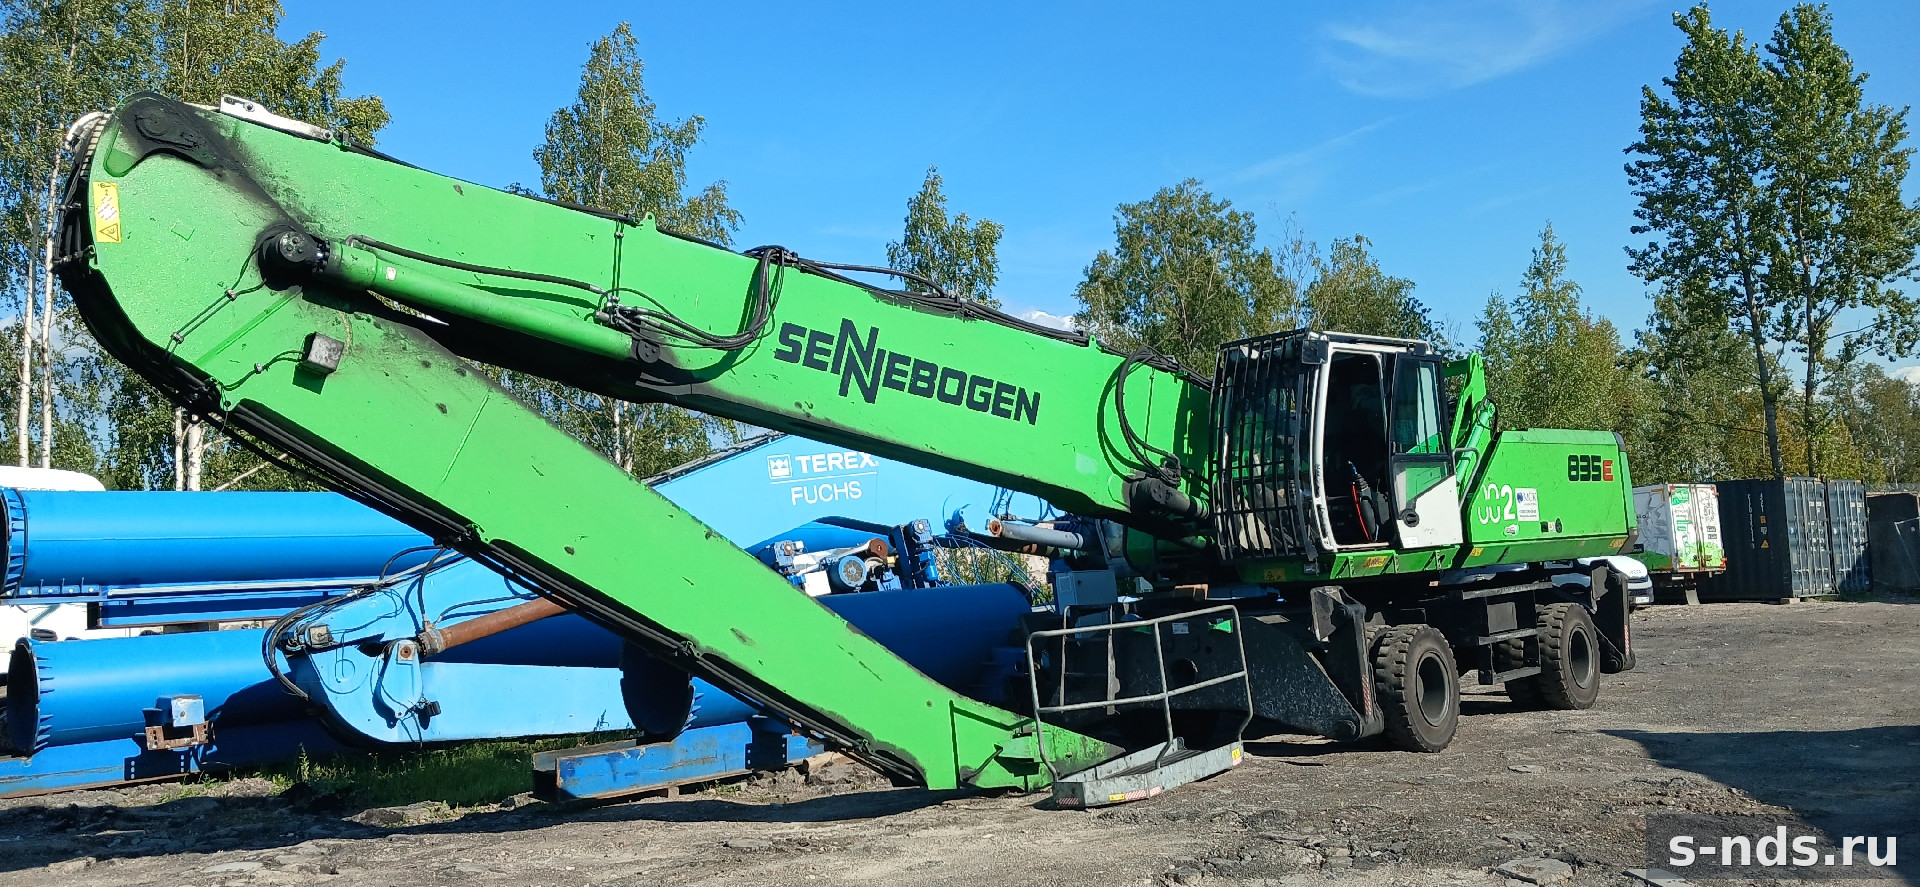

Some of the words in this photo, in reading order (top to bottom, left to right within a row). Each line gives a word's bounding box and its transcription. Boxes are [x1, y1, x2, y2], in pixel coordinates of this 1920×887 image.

[774, 318, 1041, 426] SENNEBOGEN
[795, 451, 876, 473] TEREX
[1568, 455, 1613, 481] 835E
[791, 481, 862, 506] FUCHS
